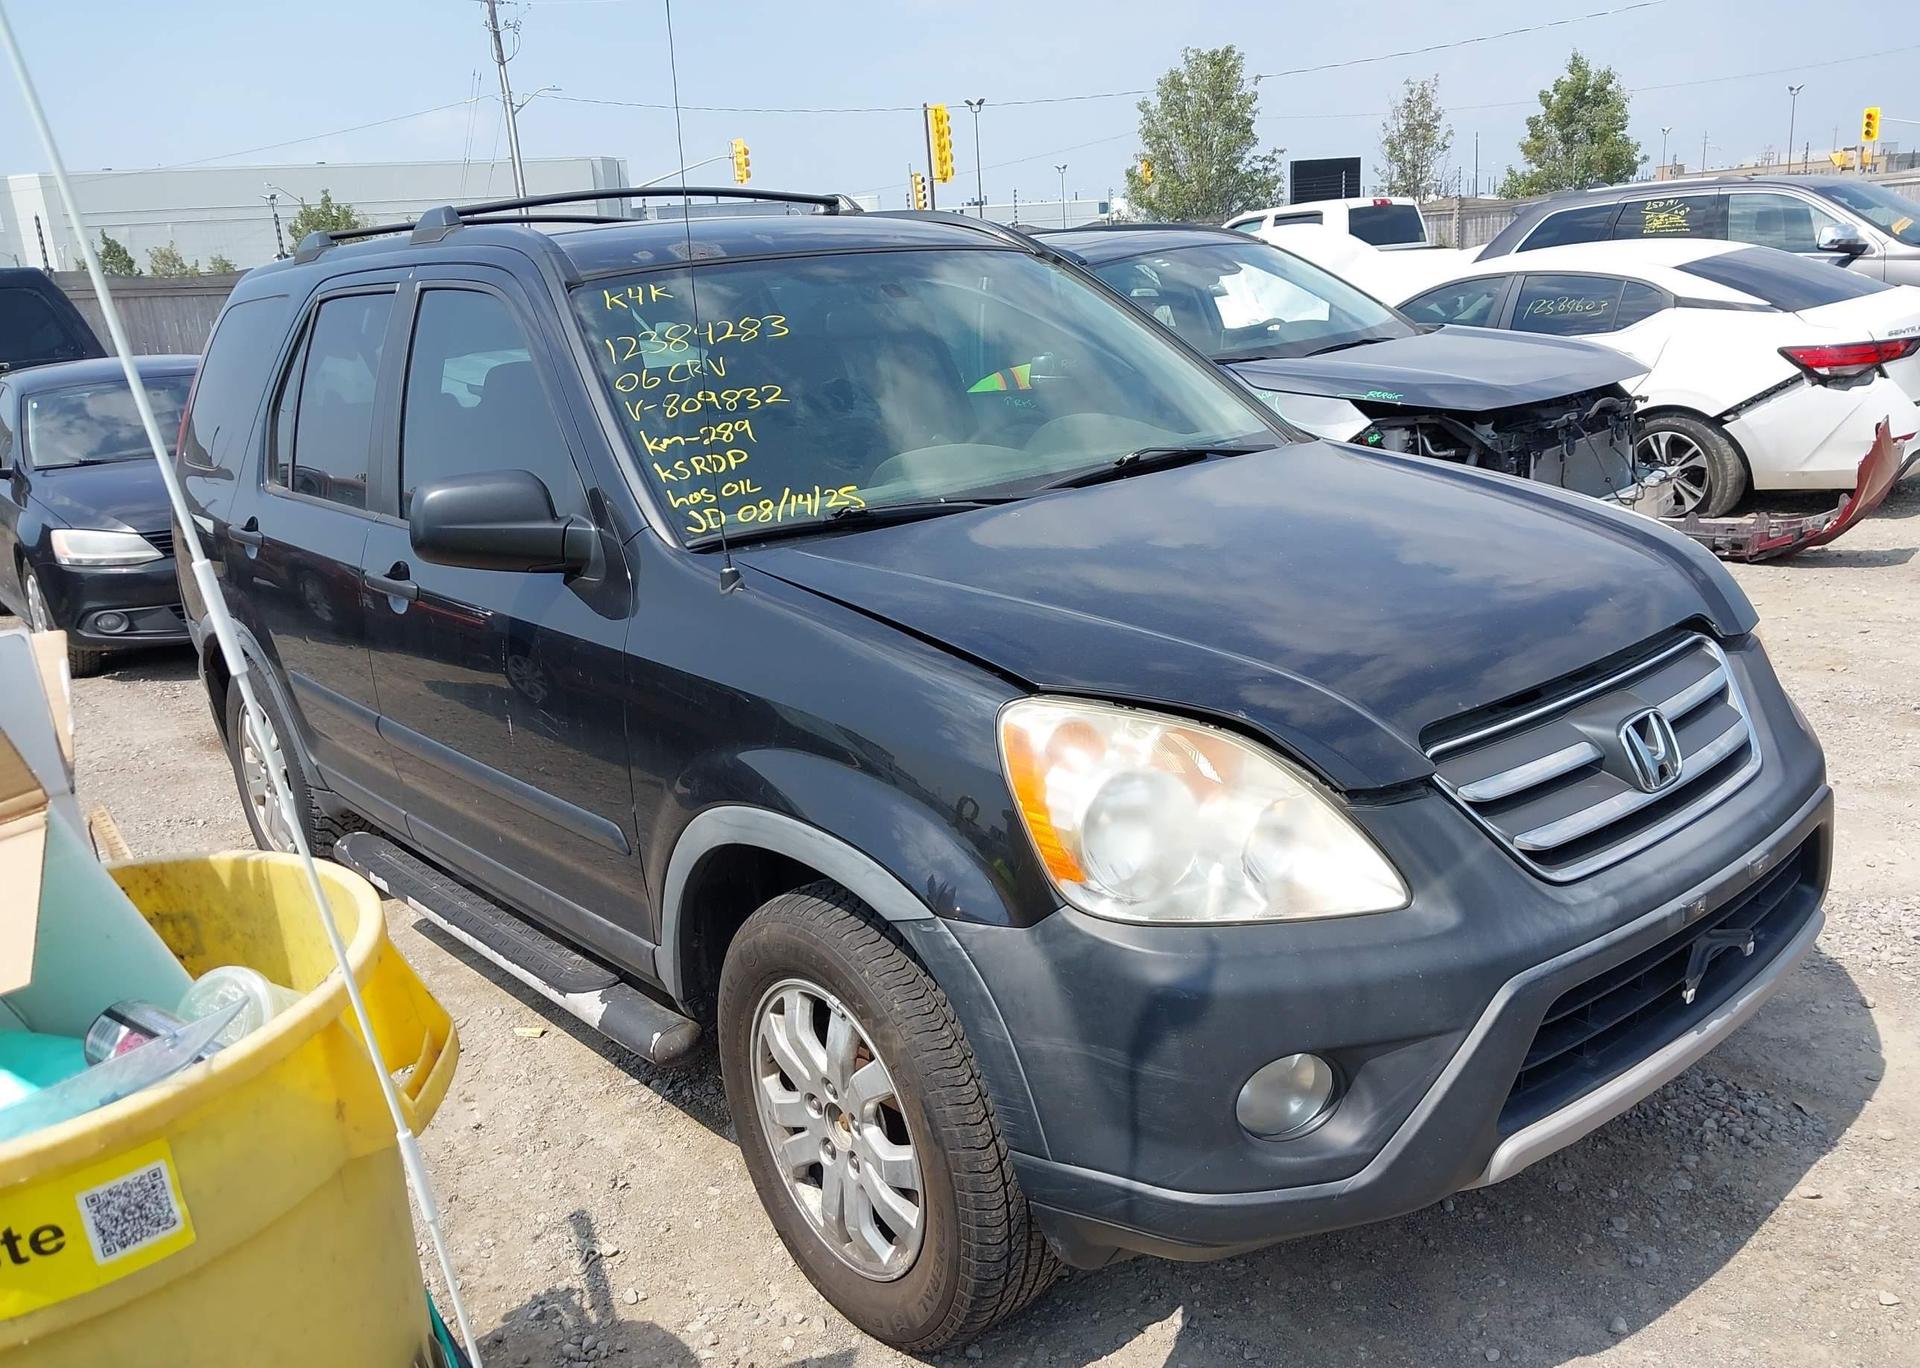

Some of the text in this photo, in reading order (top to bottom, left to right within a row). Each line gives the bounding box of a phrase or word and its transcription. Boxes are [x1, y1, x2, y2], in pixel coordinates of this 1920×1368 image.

[605, 314, 790, 365] 12384283
[668, 356, 726, 383] CRV
[625, 384, 790, 421] V-809832
[721, 478, 762, 497] OIL
[686, 485, 866, 533] JD 08/14/25
